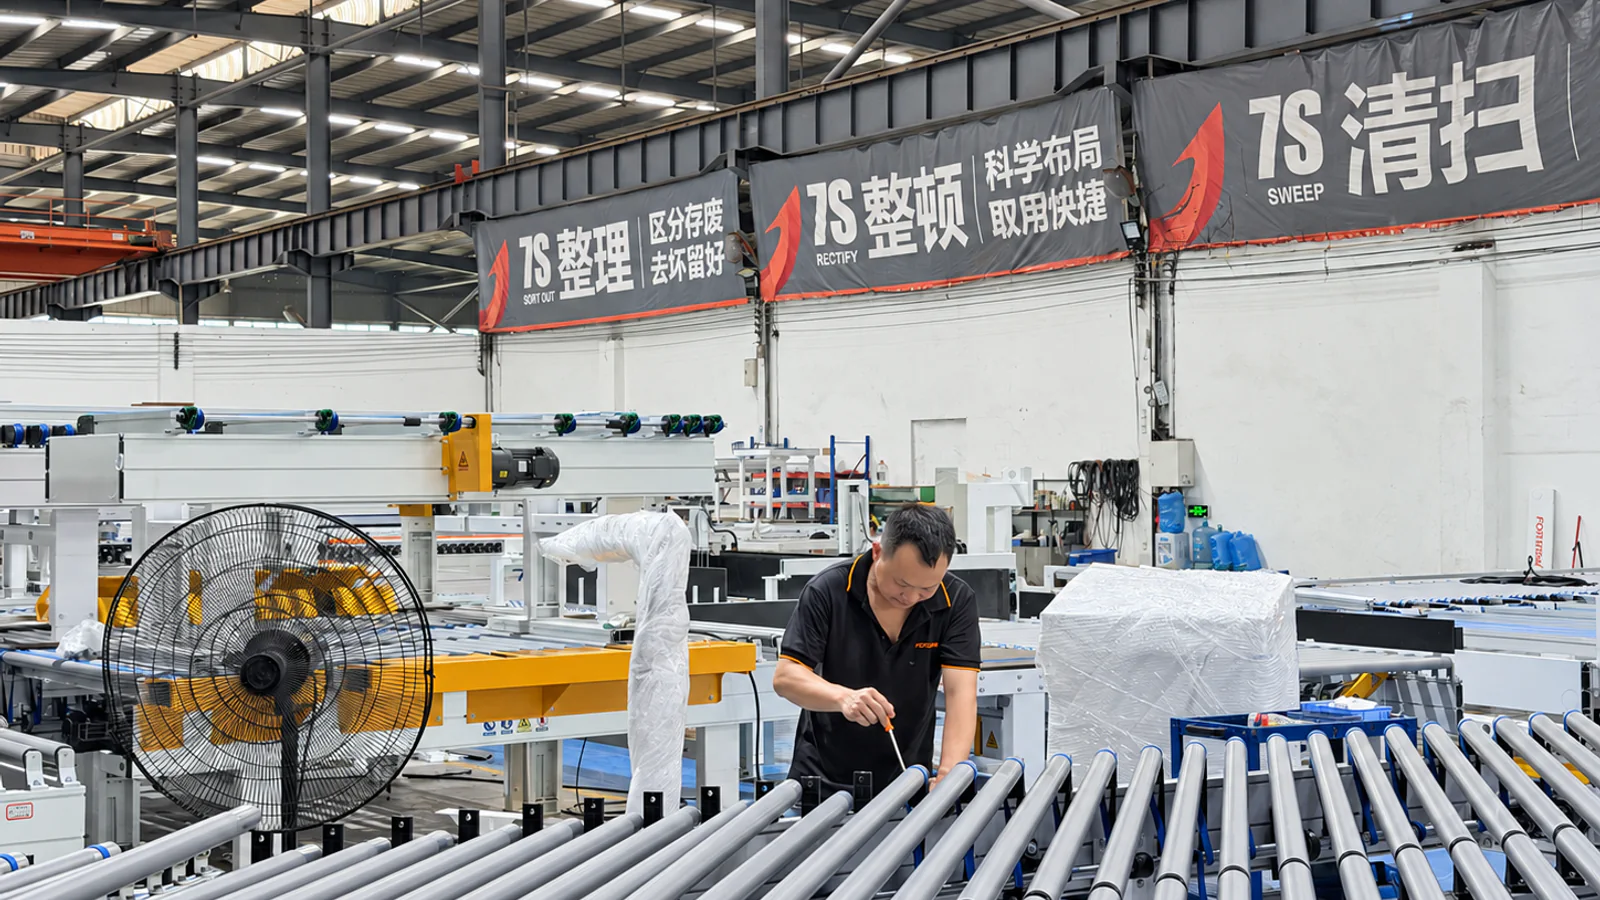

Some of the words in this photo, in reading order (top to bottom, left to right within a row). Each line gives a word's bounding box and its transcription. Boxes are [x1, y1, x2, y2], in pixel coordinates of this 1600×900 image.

[1248, 89, 1324, 180] 7S
[1341, 55, 1544, 196] 清扫
[984, 125, 1103, 192] 科学布局
[649, 197, 724, 246] 区分存废
[806, 178, 858, 246] 7S
[861, 162, 969, 259] 整顿
[988, 178, 1108, 240] 取用快捷
[1267, 183, 1325, 206] SWEEP
[519, 232, 552, 289] 7S
[556, 220, 635, 300] 整理
[650, 240, 726, 286] 去坏留好
[816, 250, 858, 267] RECTIFY
[523, 292, 541, 305] SORT
[541, 290, 556, 303] OUT
